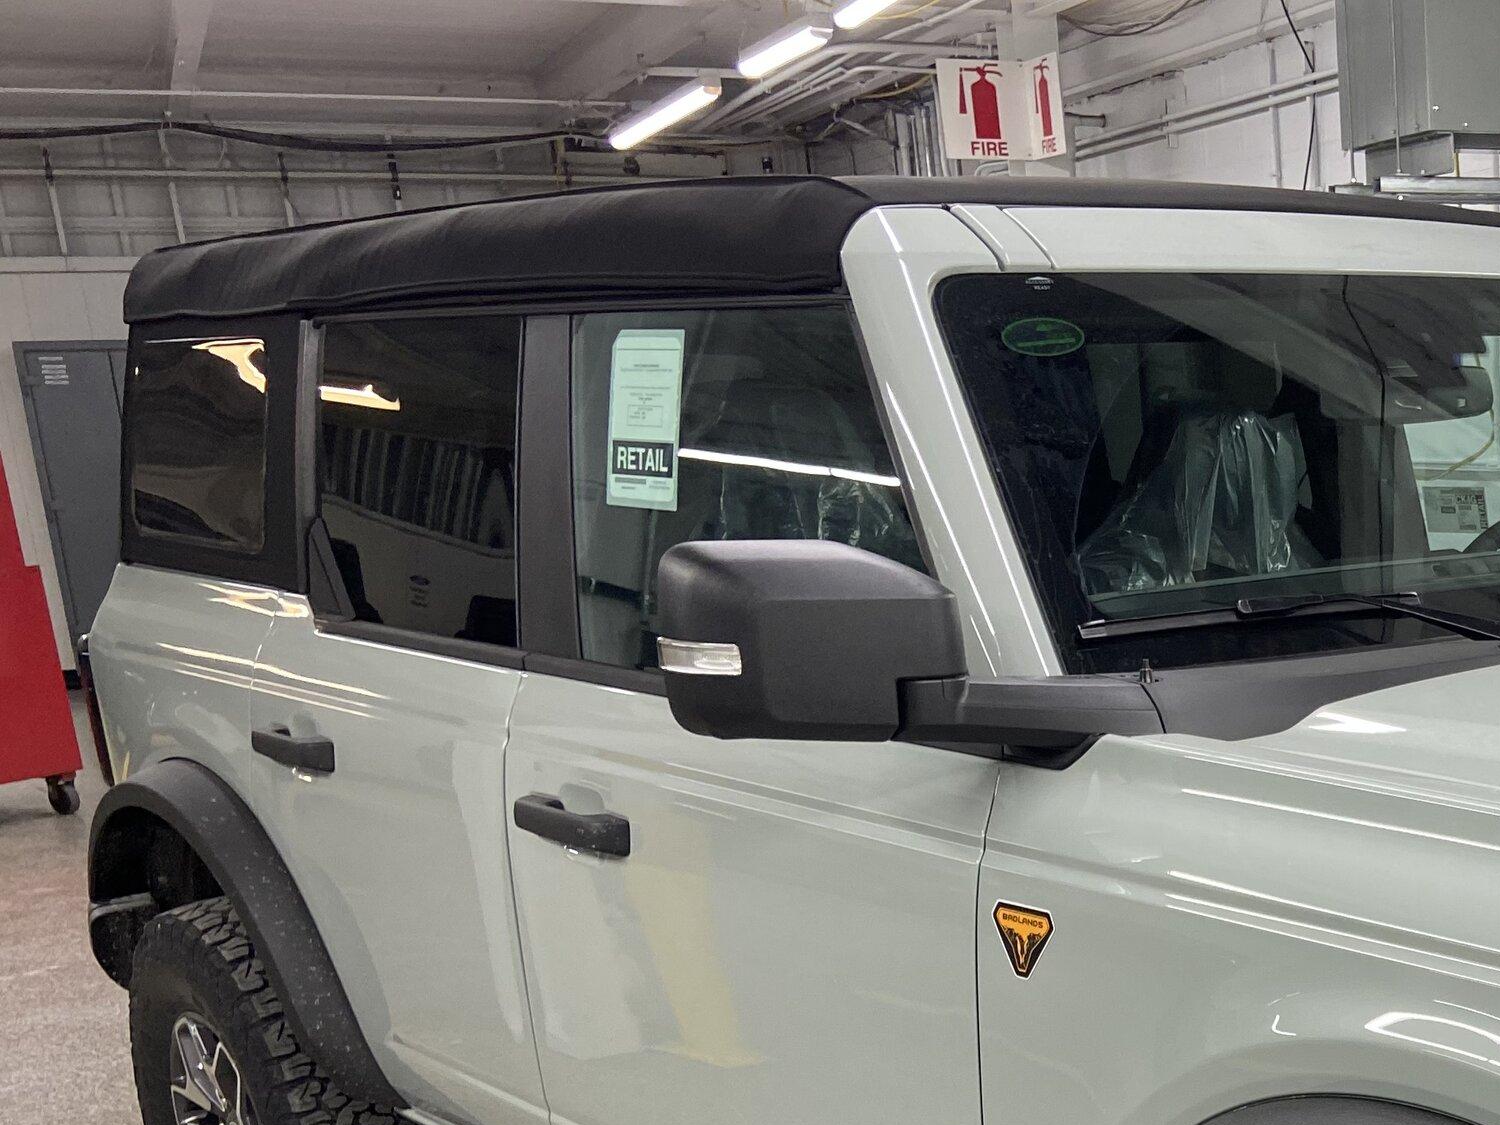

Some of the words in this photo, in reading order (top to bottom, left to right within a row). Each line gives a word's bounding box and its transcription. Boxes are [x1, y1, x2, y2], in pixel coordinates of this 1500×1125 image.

[971, 141, 1009, 157] FIRE
[1041, 137, 1057, 155] FIRE
[616, 446, 669, 473] RETAIL
[1002, 912, 1044, 929] BADLANDS
